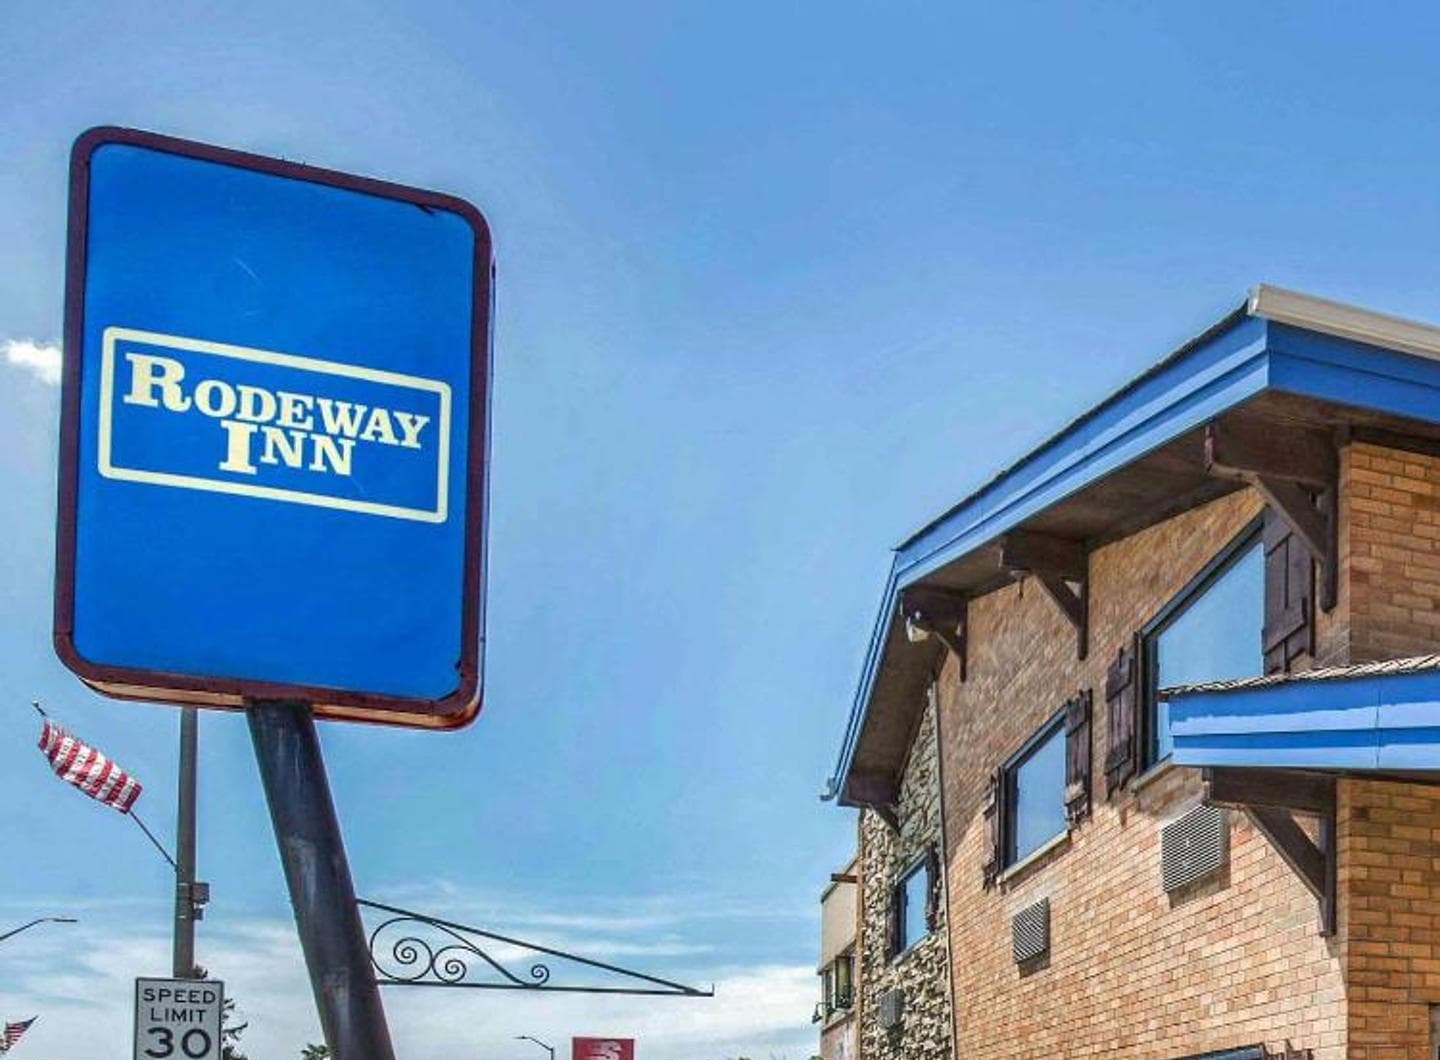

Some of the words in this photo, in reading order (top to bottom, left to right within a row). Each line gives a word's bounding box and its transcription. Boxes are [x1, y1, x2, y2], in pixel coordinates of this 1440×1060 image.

[123, 352, 430, 449] RODEWAY
[218, 420, 356, 476] INN
[143, 988, 216, 1004] SPEED
[150, 1007, 207, 1023] LIMIT
[144, 1026, 212, 1060] 30
